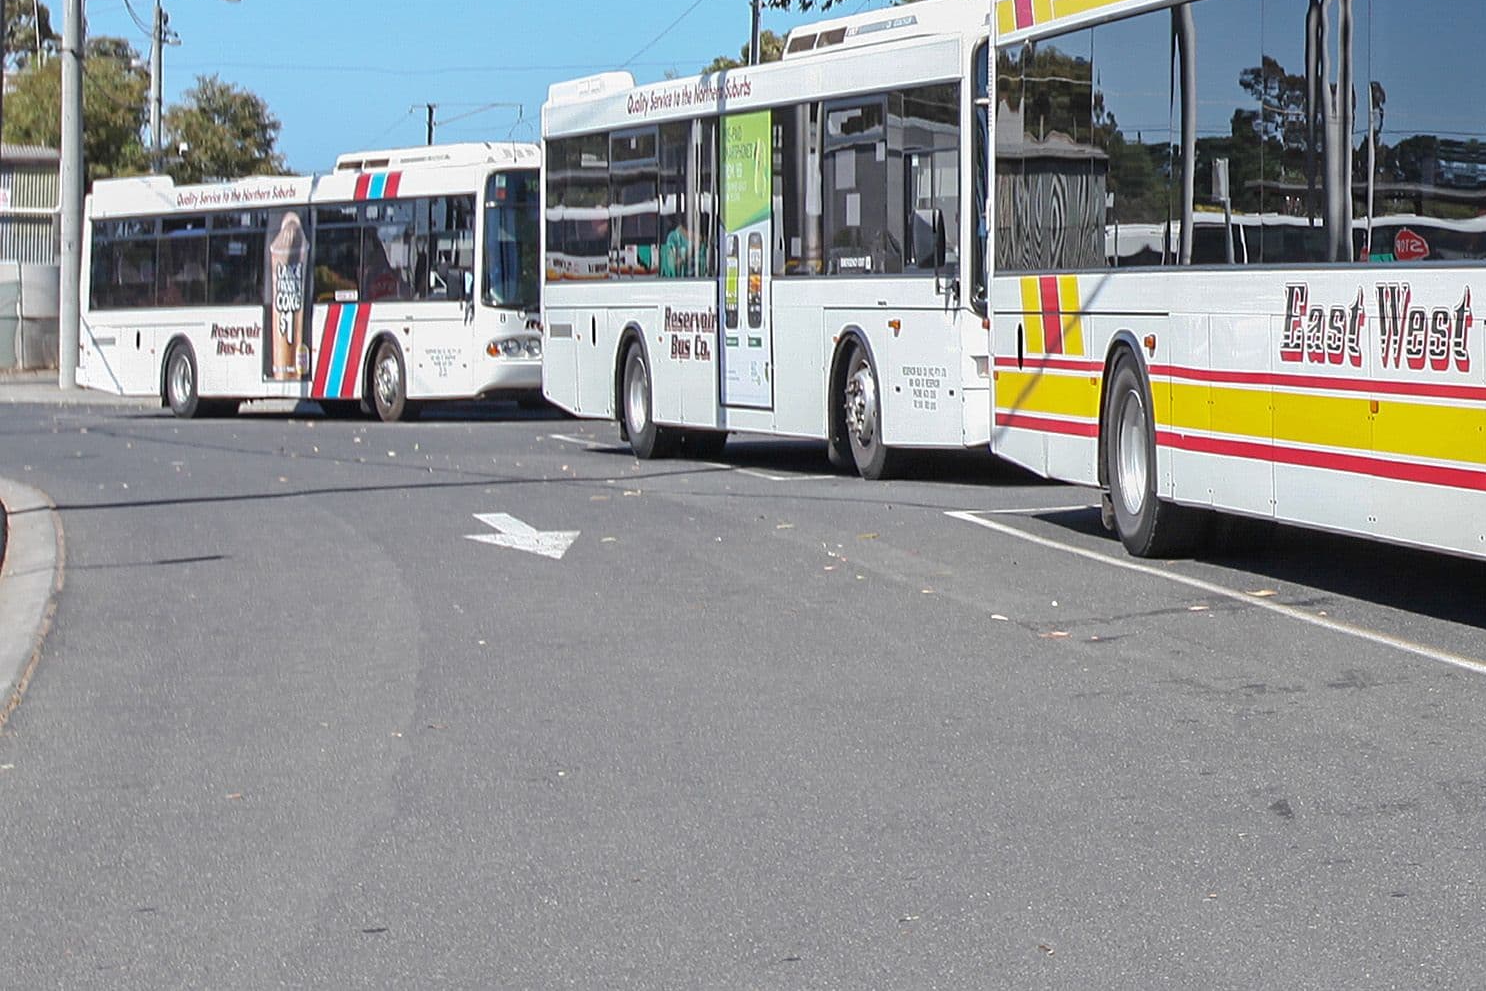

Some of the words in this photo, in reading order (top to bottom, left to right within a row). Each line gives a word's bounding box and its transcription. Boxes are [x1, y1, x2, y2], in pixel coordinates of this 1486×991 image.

[650, 88, 672, 111] Service
[673, 91, 680, 108] to
[681, 85, 692, 106] the
[211, 321, 261, 338] Reservoir
[663, 305, 717, 334] Reservoir
[1280, 282, 1365, 368] East
[1375, 282, 1473, 372] West
[670, 333, 691, 360] Bus
